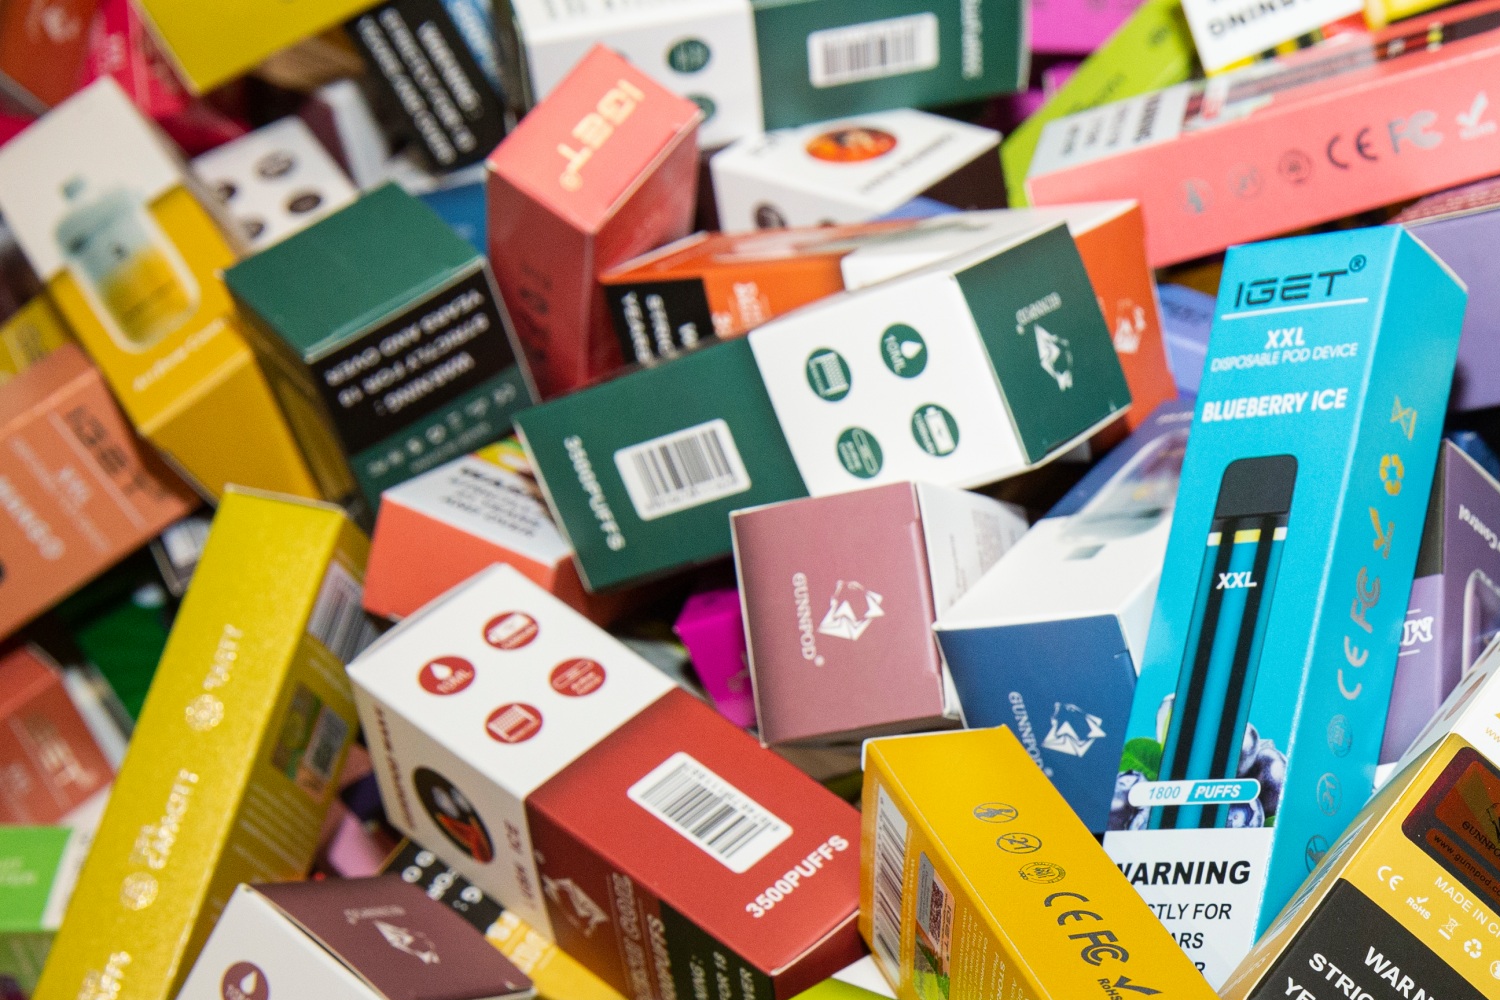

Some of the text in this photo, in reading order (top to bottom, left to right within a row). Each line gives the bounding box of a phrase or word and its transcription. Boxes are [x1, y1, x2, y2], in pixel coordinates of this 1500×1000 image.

[1264, 327, 1306, 349] XXL
[1210, 342, 1358, 373] DISPOSABLE POD DEVICE
[1202, 388, 1348, 423] BLUEBERRY ICE
[1215, 571, 1258, 591] XXL
[1149, 784, 1241, 800] 1800 PUFFS
[745, 835, 849, 918] 3500PUFFS
[1434, 876, 1474, 914] MADE
[1193, 903, 1232, 920] FOR
